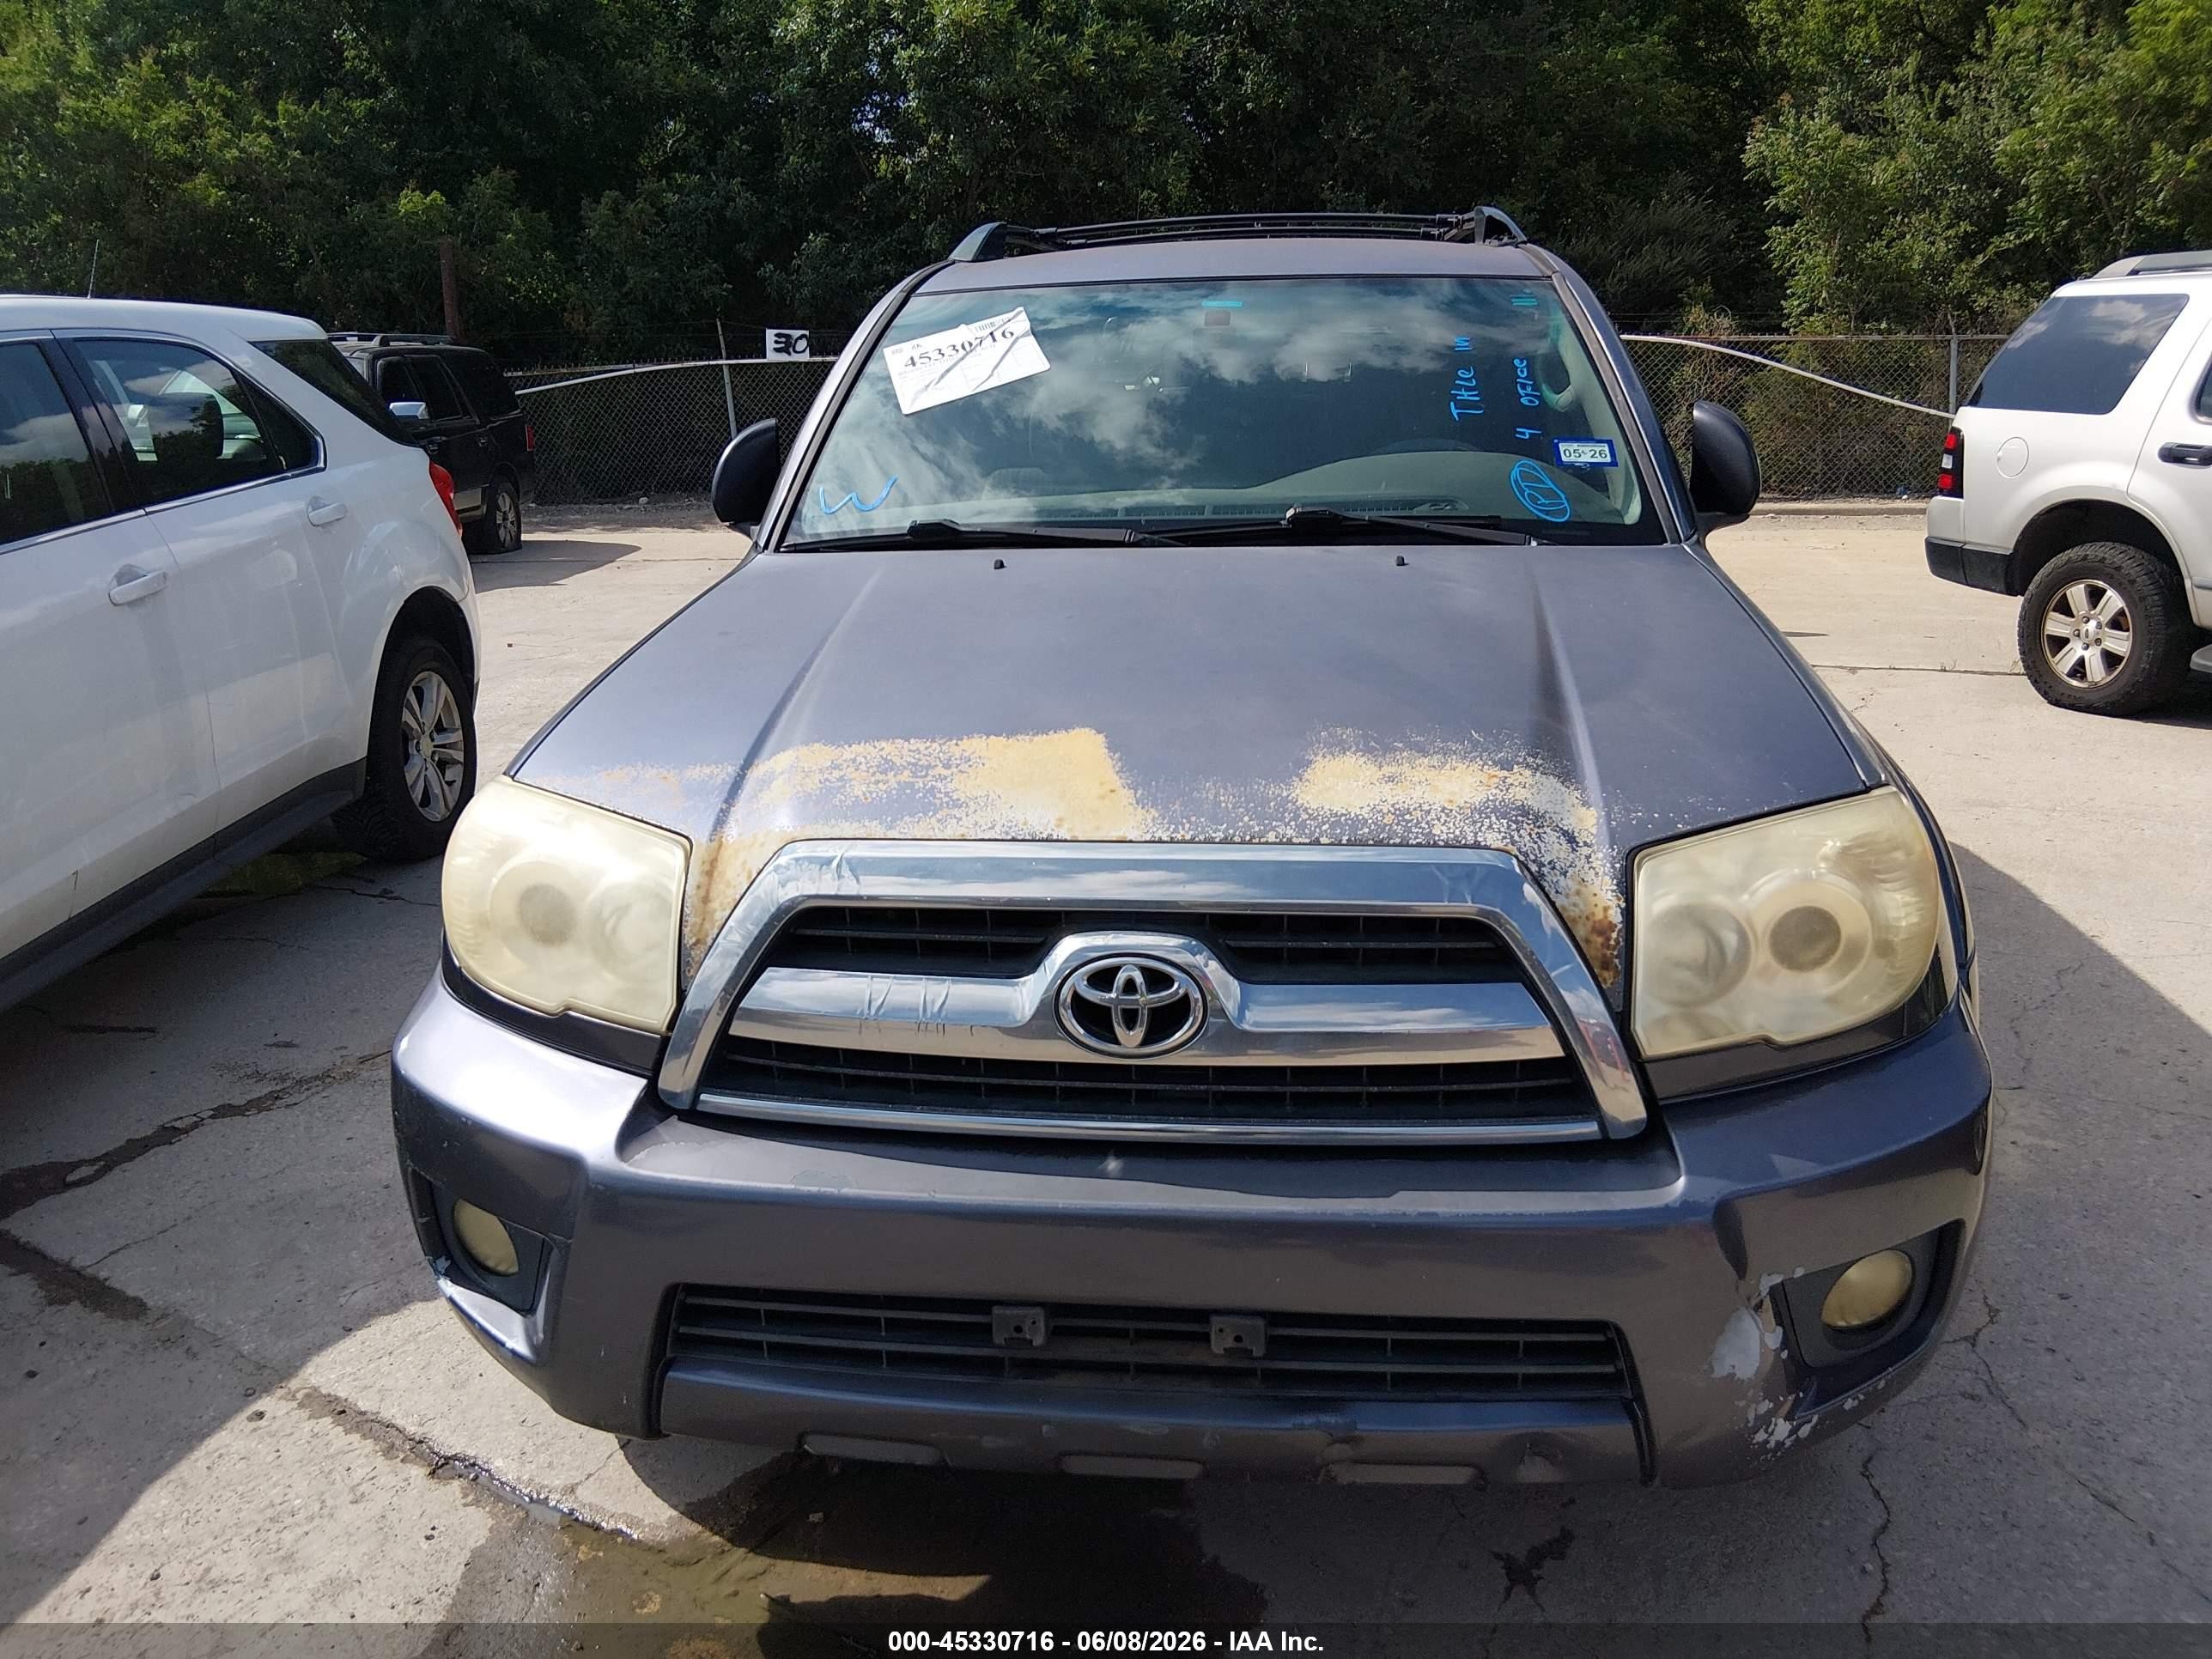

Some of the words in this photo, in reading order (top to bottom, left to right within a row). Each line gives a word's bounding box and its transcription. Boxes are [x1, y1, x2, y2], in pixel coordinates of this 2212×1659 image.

[773, 332, 809, 356] 30
[904, 326, 1014, 368] 45330716
[1563, 448, 1582, 459] 05
[1589, 448, 1607, 459] 26
